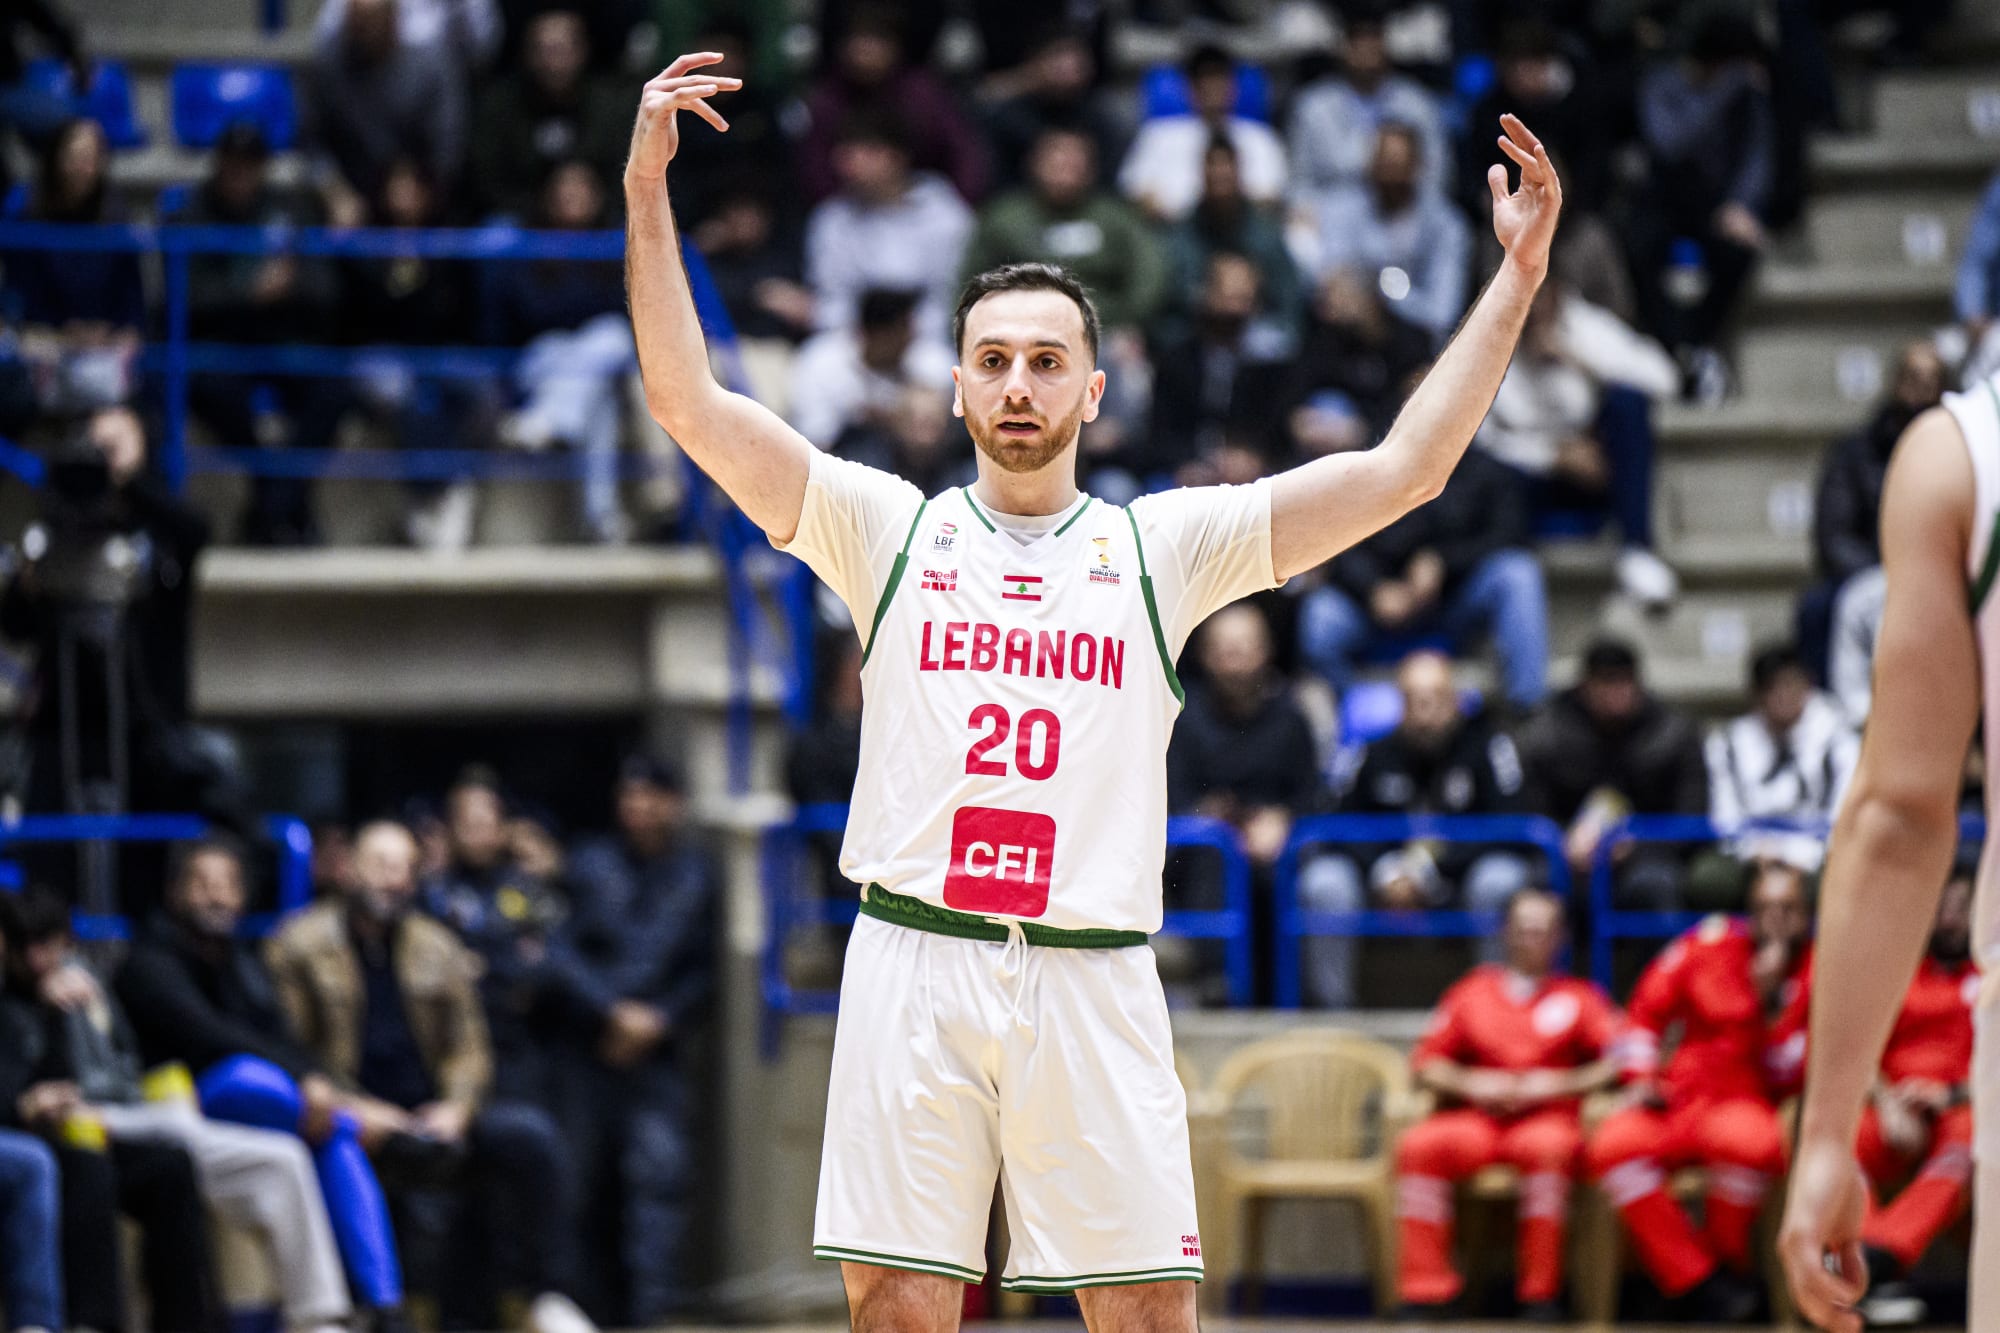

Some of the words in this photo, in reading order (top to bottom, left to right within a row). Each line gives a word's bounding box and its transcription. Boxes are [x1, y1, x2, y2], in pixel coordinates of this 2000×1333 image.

[935, 535, 956, 547] LBF
[923, 569, 958, 580] capelli
[1089, 575, 1121, 584] QUALIFIERS
[920, 621, 1125, 690] LEBANON
[965, 703, 1061, 781] 20
[964, 841, 1038, 884] CFI
